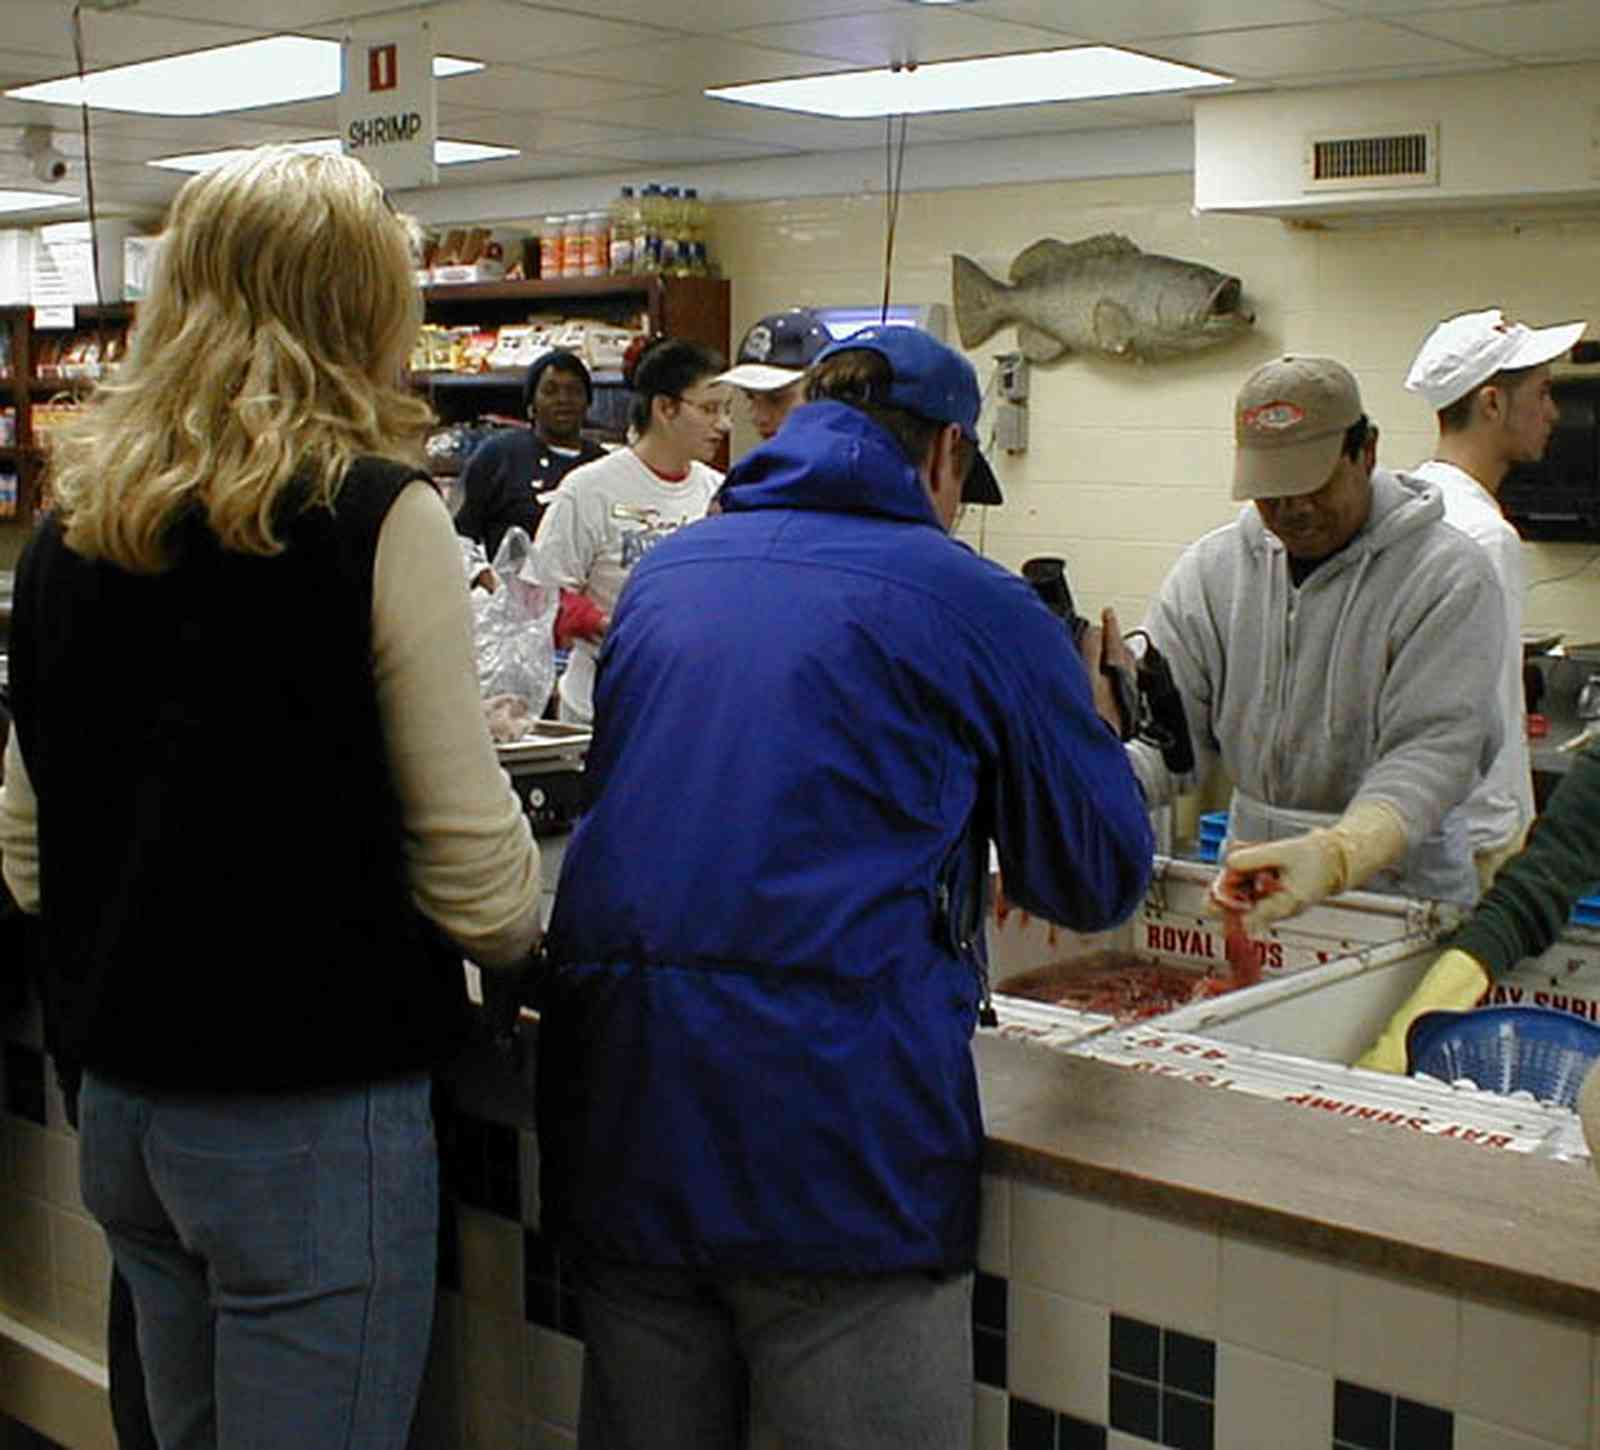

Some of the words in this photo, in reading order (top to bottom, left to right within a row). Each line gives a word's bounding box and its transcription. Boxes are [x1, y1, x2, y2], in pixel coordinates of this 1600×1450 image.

[348, 112, 422, 149] SHRIMP
[1146, 923, 1215, 959] ROYAL
[1283, 1093, 1430, 1131] SHRIMP
[1440, 1125, 1514, 1148] BAY
